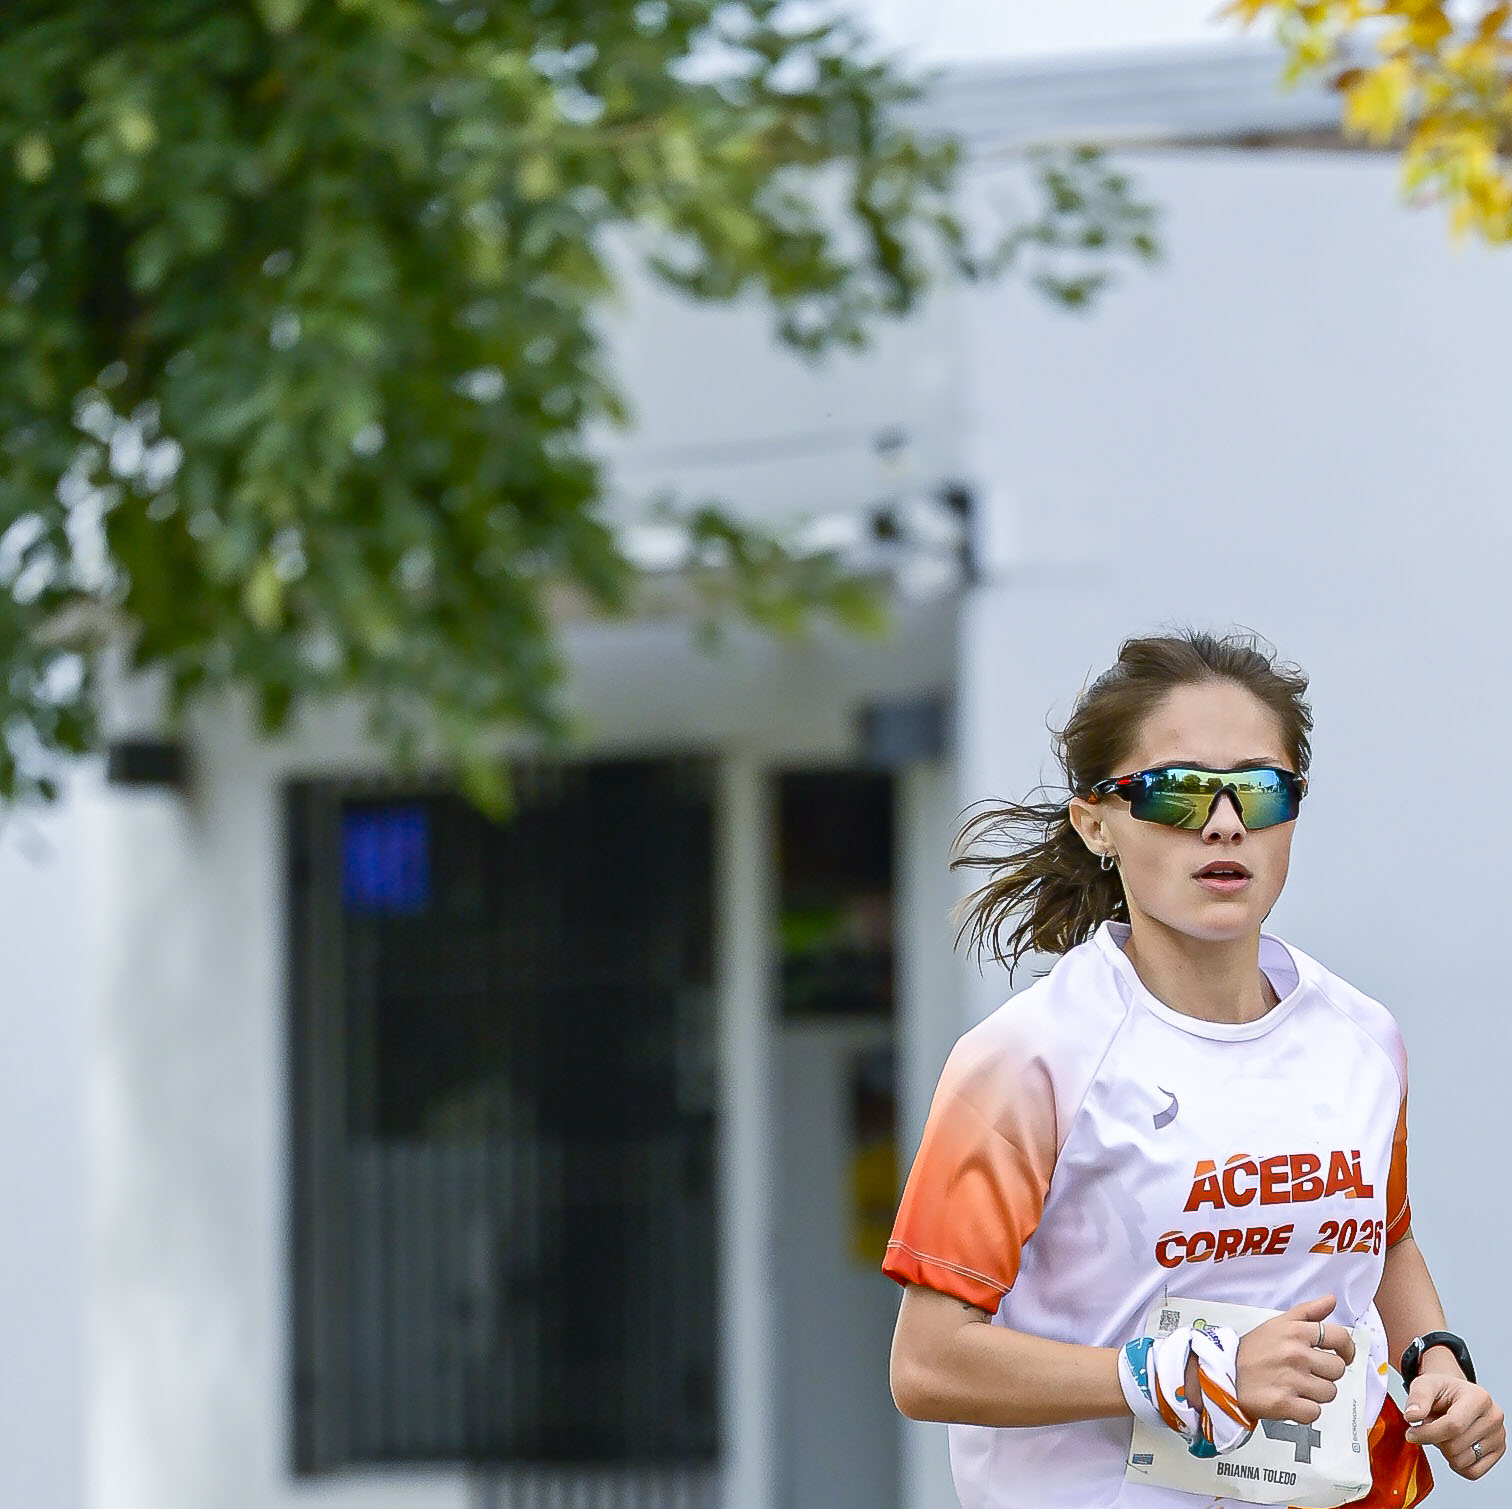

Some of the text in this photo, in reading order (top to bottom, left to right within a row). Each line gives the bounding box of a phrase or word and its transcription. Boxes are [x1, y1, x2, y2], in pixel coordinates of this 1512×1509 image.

[1183, 1150, 1374, 1212] ACEBAL
[1155, 1218, 1383, 1268] CORRE 2026
[1217, 1462, 1297, 1485] BRIANNA TOLEDO
